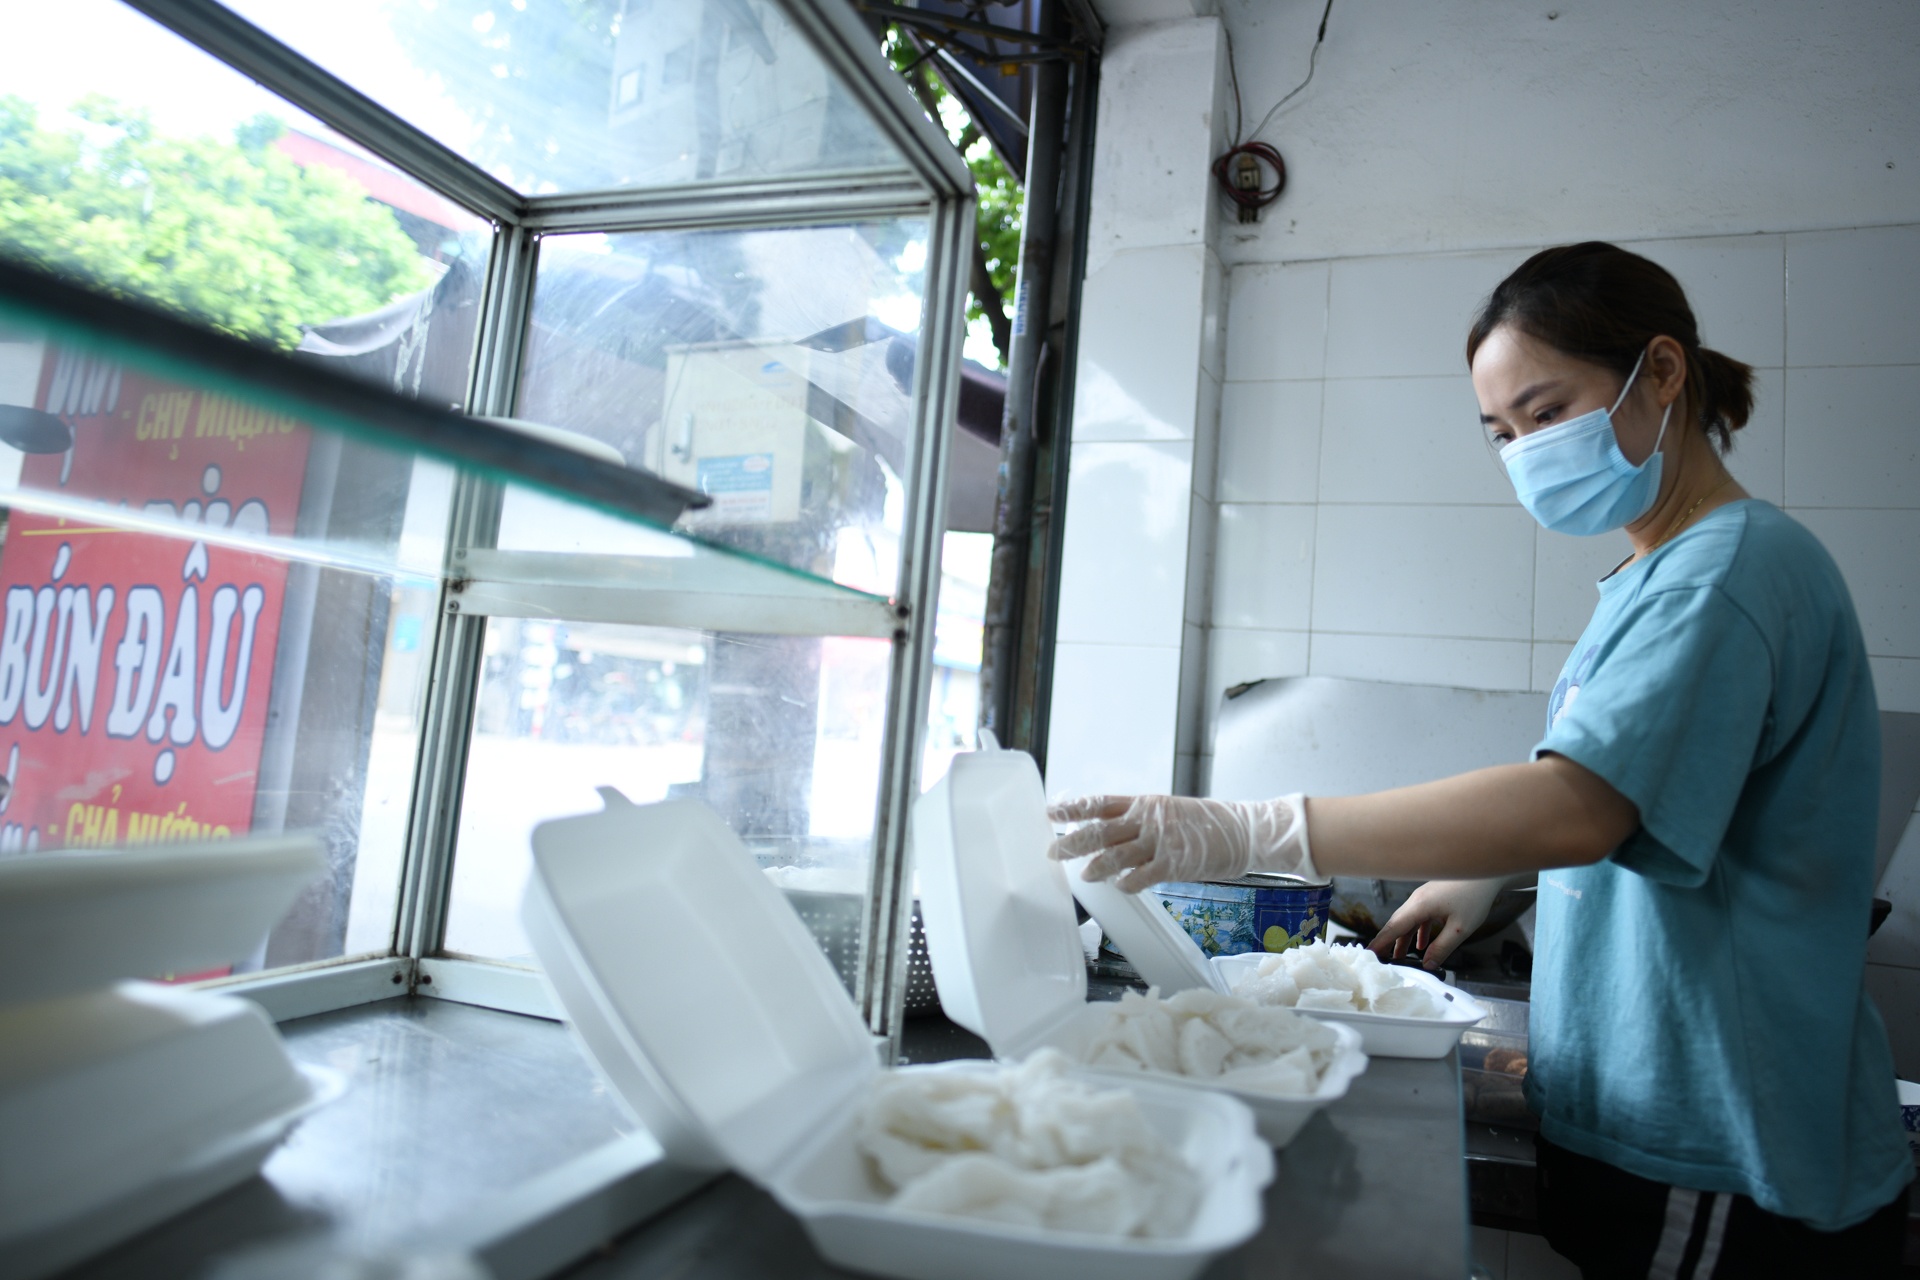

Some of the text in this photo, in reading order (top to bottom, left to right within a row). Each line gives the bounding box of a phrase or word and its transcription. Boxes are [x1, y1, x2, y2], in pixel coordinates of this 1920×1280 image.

[0, 538, 265, 786] BÚN ĐẬU
[65, 784, 121, 850] CHẢ
